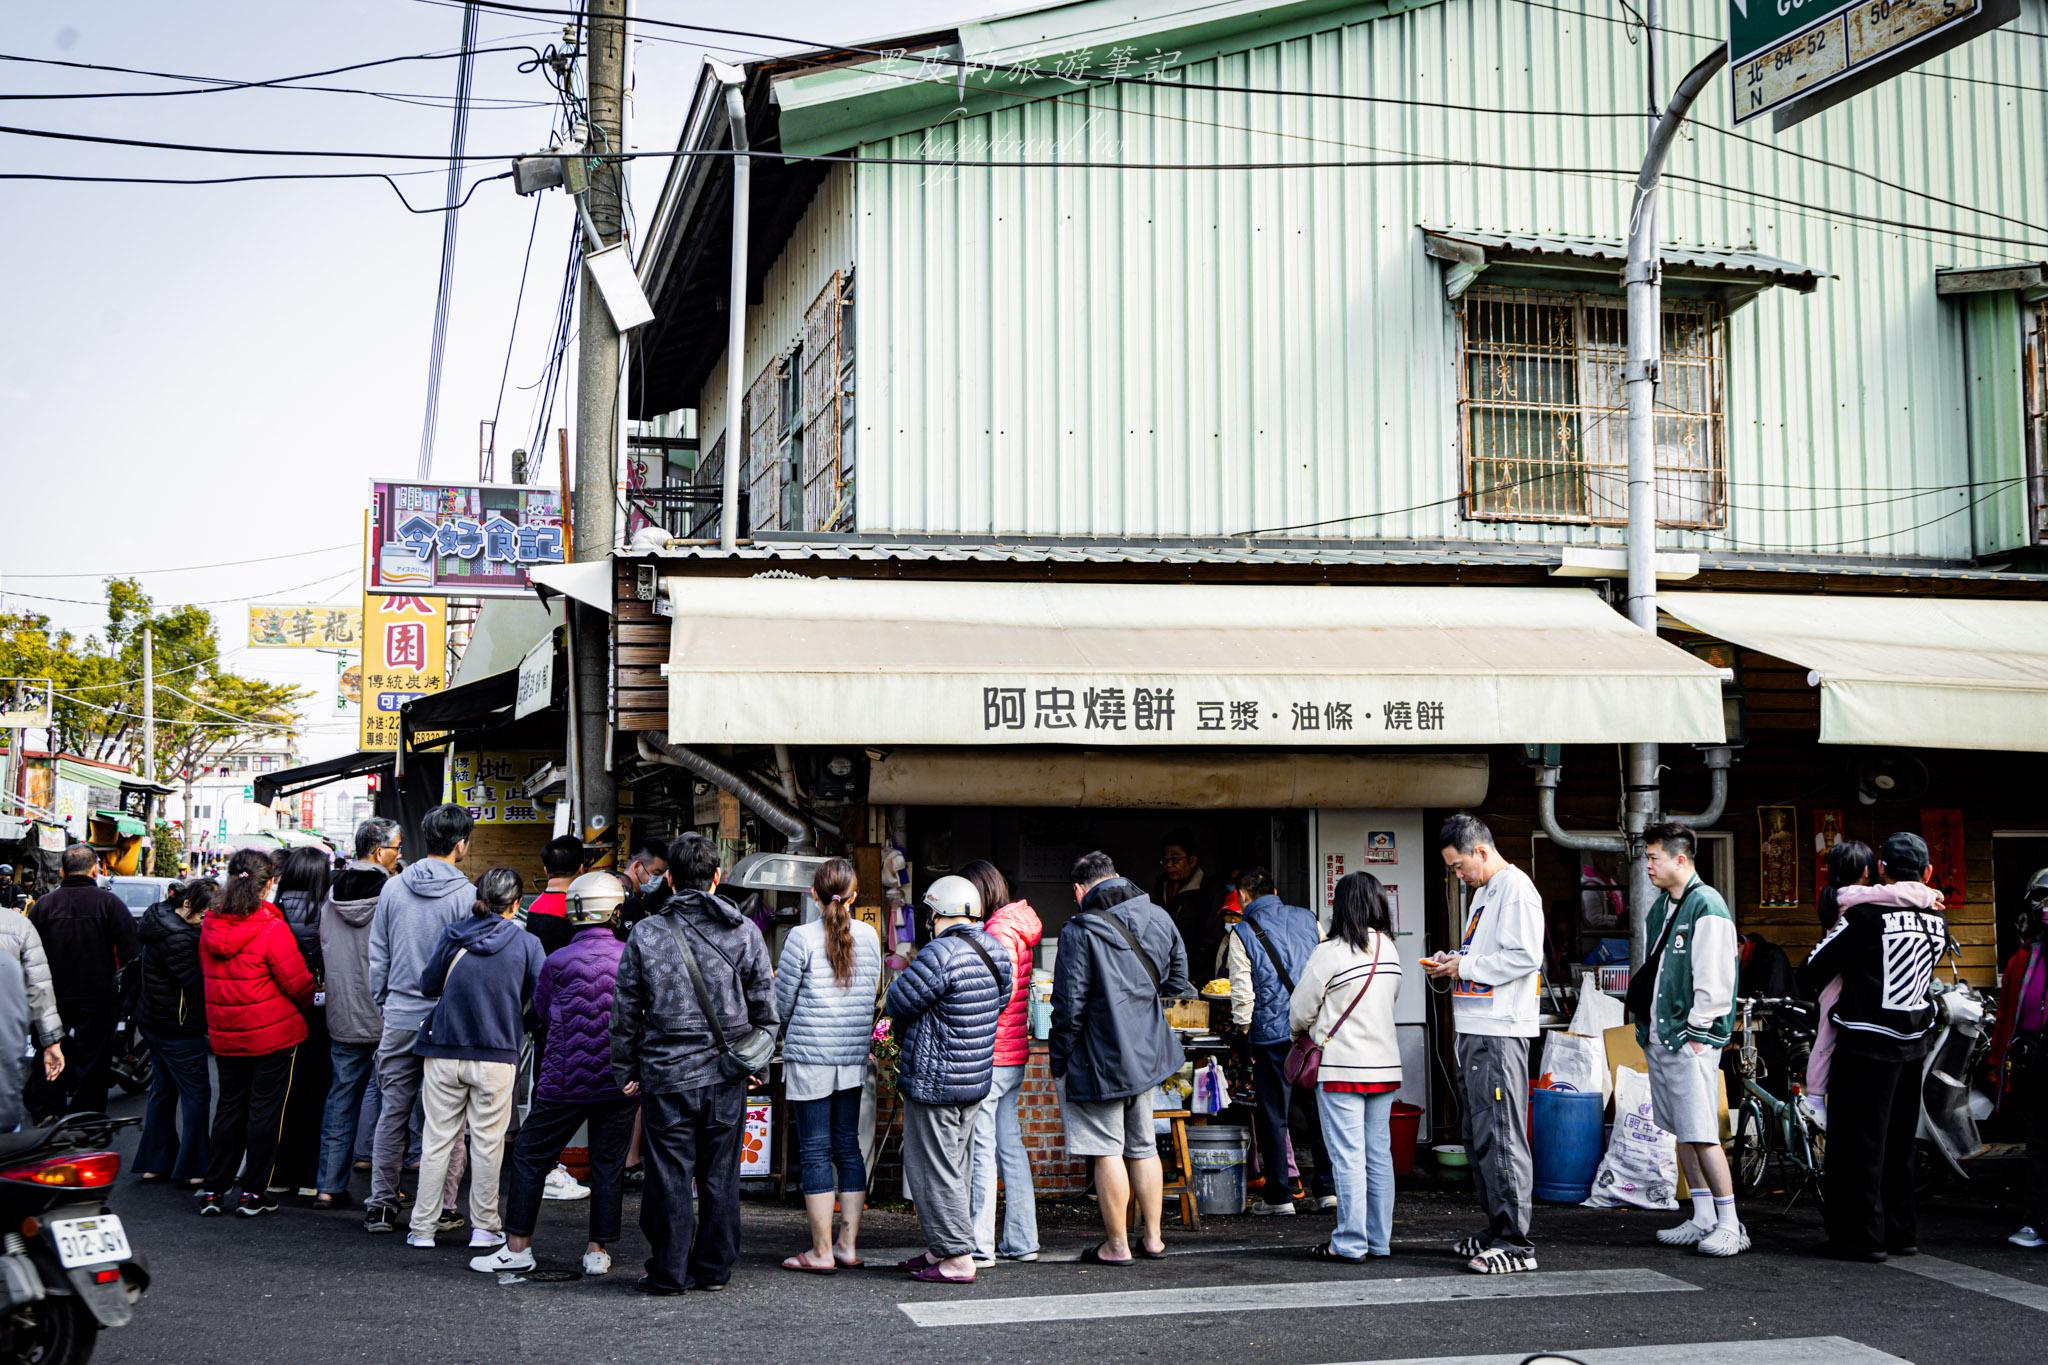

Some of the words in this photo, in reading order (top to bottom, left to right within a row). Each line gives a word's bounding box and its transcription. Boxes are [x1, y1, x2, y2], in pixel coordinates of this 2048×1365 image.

[1775, 30, 1826, 71] 84-52
[1747, 61, 1764, 87] 北
[1750, 86, 1763, 110] N
[398, 515, 565, 562] 今好食記
[367, 674, 441, 690] 傳統炭烤
[983, 686, 1176, 731] 阿忠燒餅
[452, 757, 471, 782] 傳統
